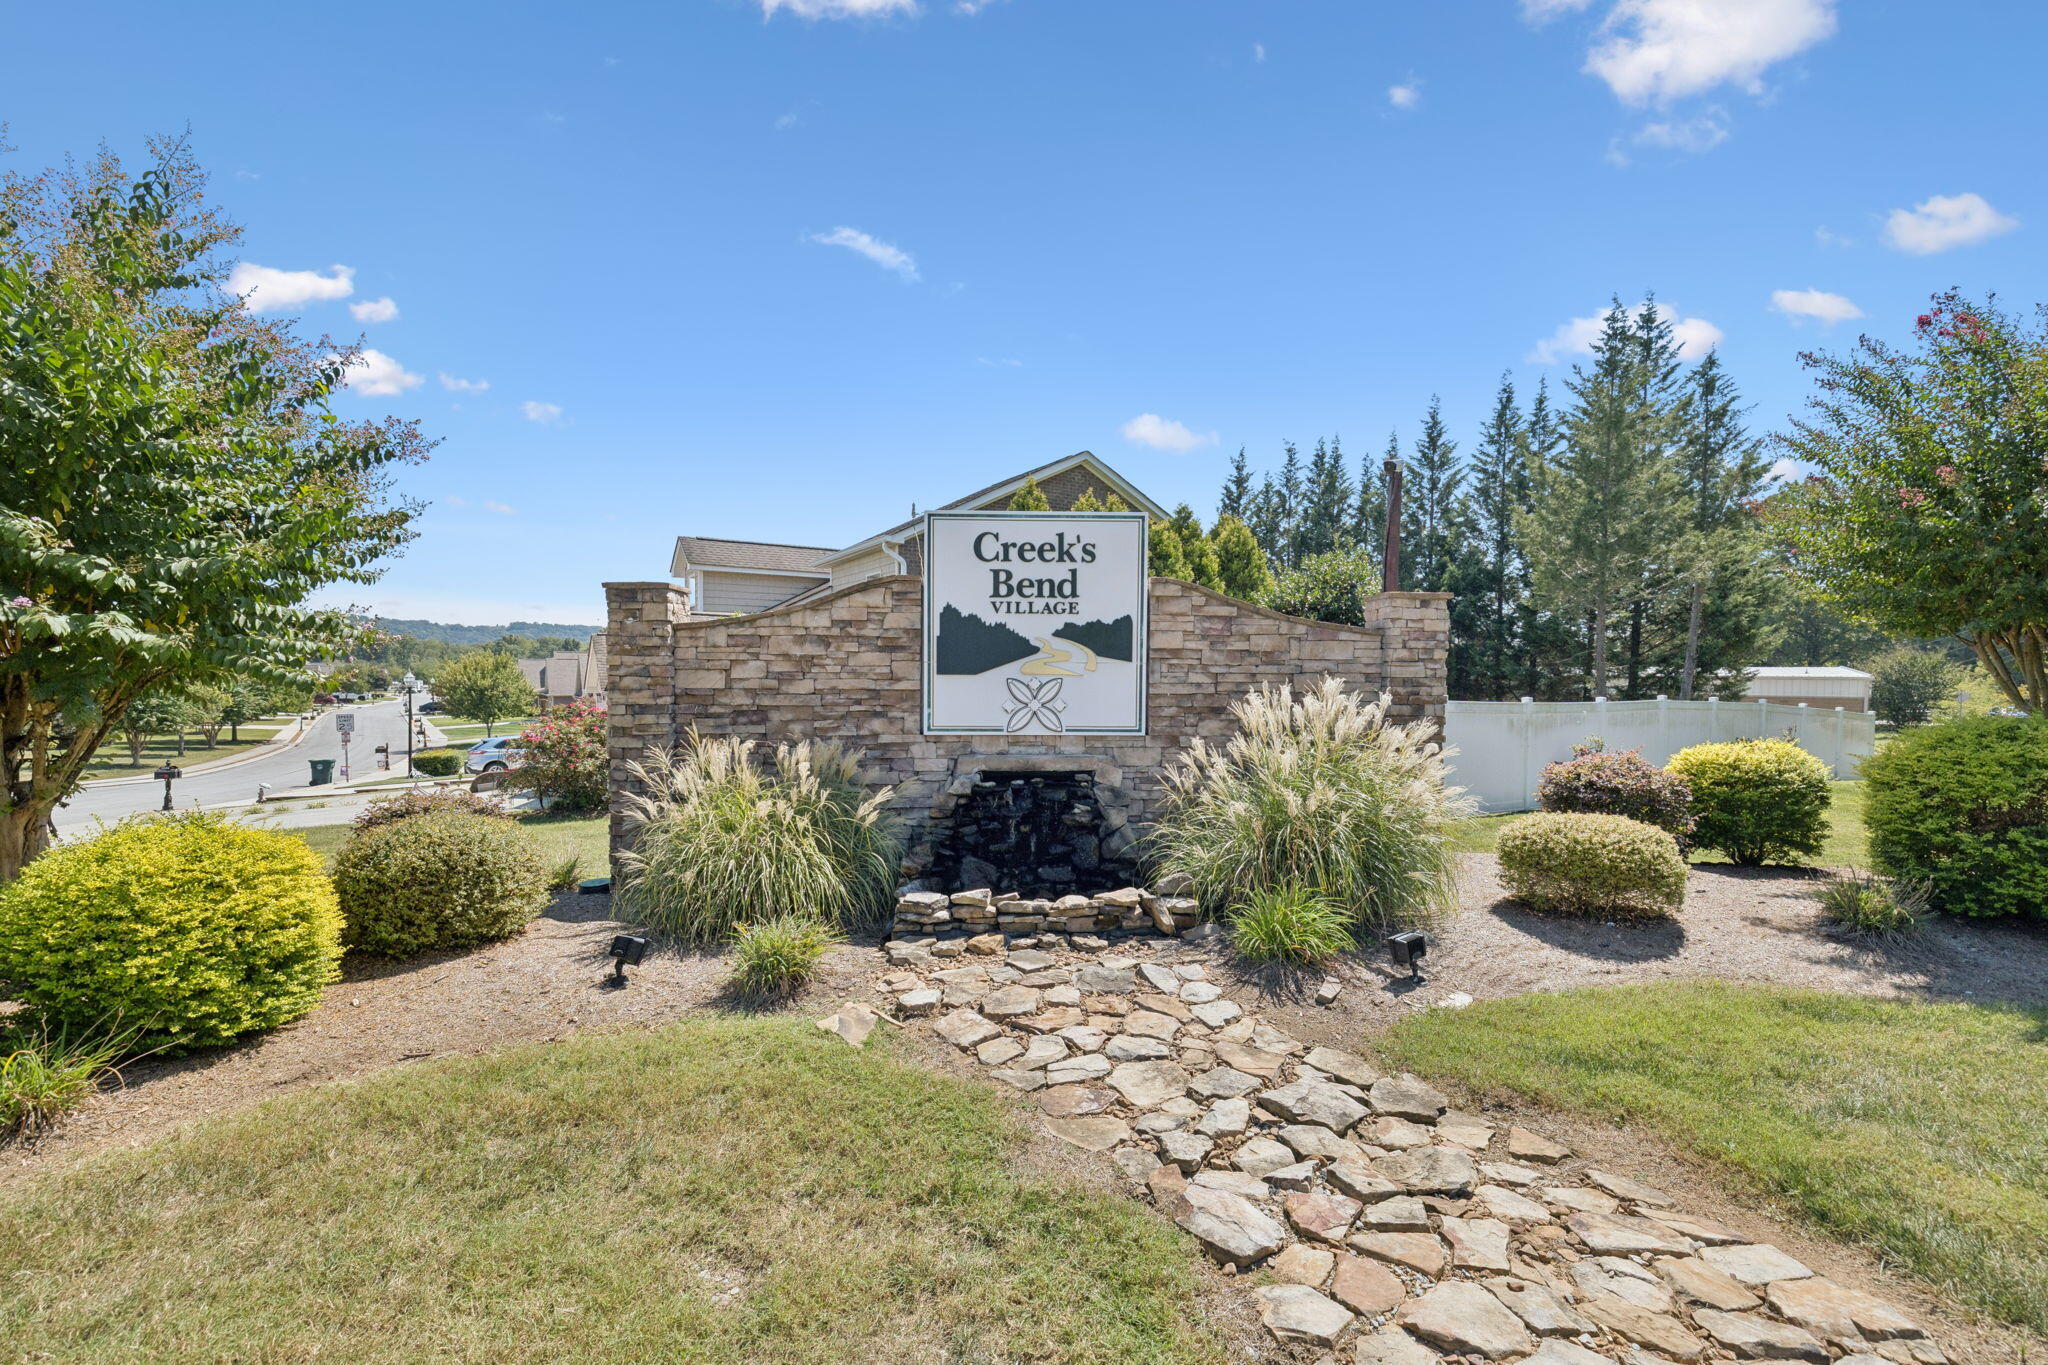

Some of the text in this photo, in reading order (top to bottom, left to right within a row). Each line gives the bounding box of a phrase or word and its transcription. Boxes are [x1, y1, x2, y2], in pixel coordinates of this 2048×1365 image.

[973, 531, 1097, 564] Creek's
[989, 568, 1080, 599] Bend
[990, 601, 1080, 615] VILLAGE
